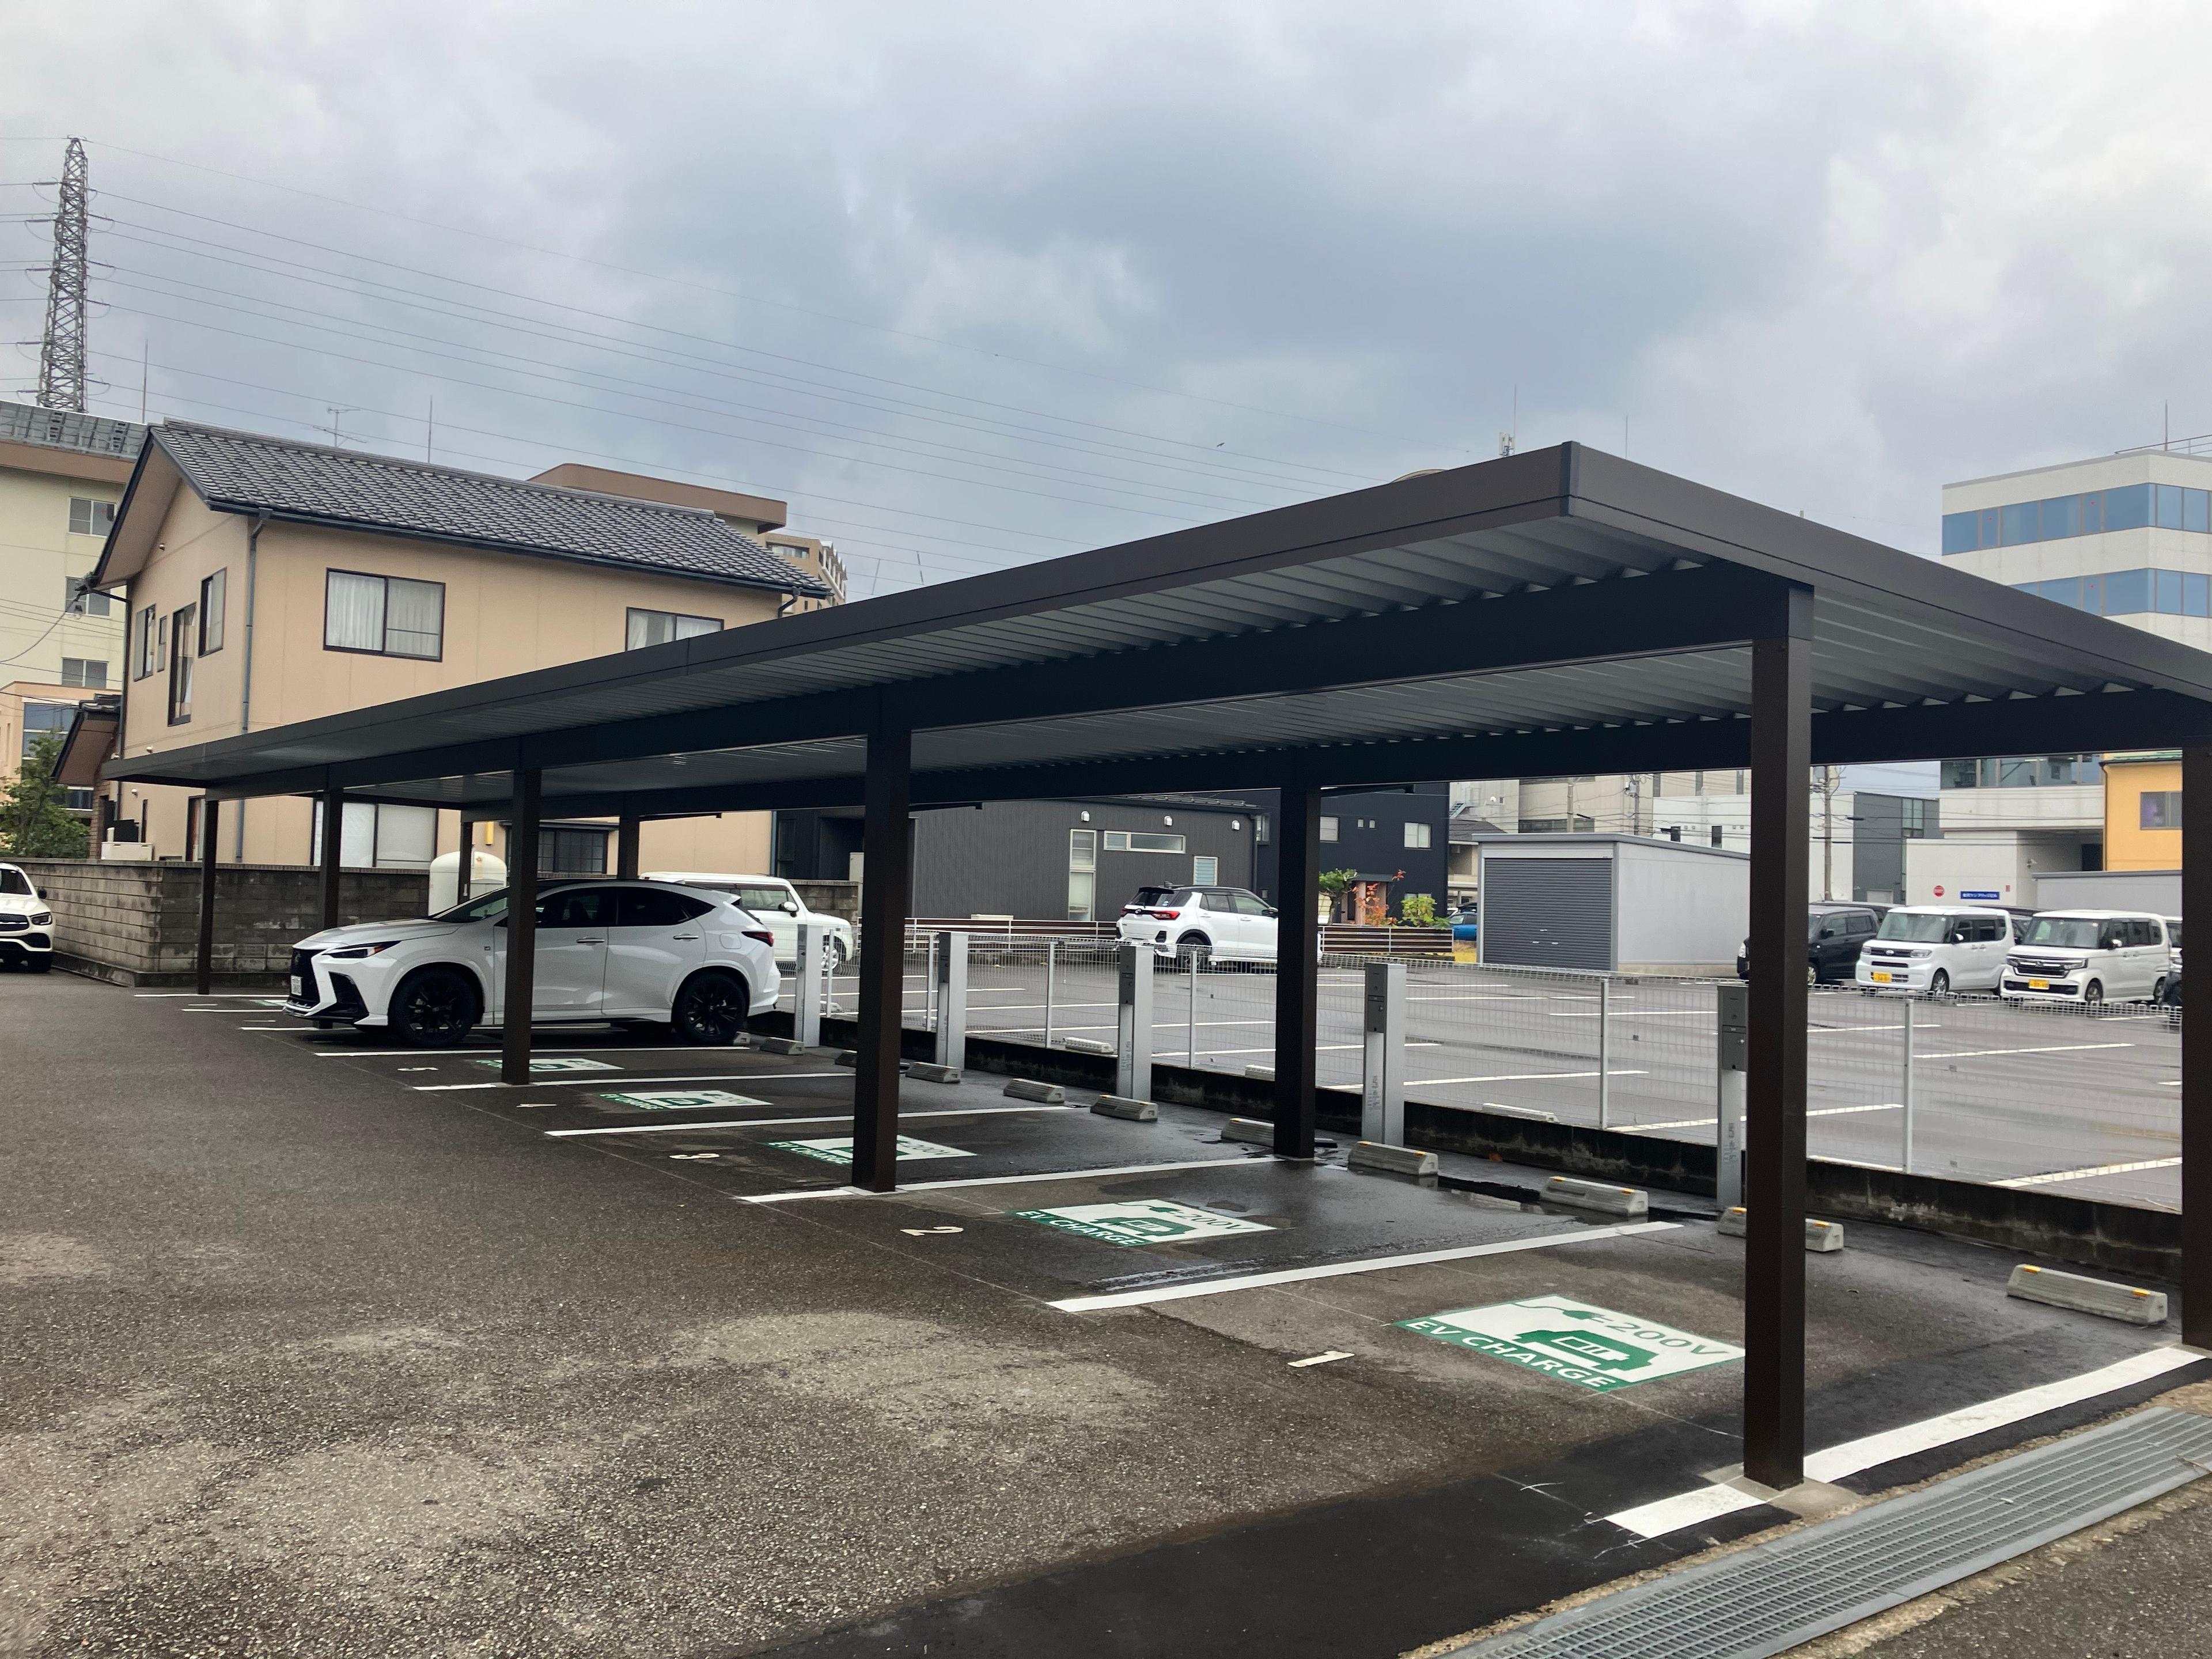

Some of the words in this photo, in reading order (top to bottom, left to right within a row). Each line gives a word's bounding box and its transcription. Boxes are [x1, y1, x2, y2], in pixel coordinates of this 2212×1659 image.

[1016, 1211, 1054, 1219] EV
[1048, 1219, 1145, 1245] CHARGE
[1175, 1214, 1255, 1229] 200V
[1406, 1321, 1462, 1335] EV
[1461, 1336, 1616, 1388] CHARGE
[1604, 1322, 1732, 1357] 200V
